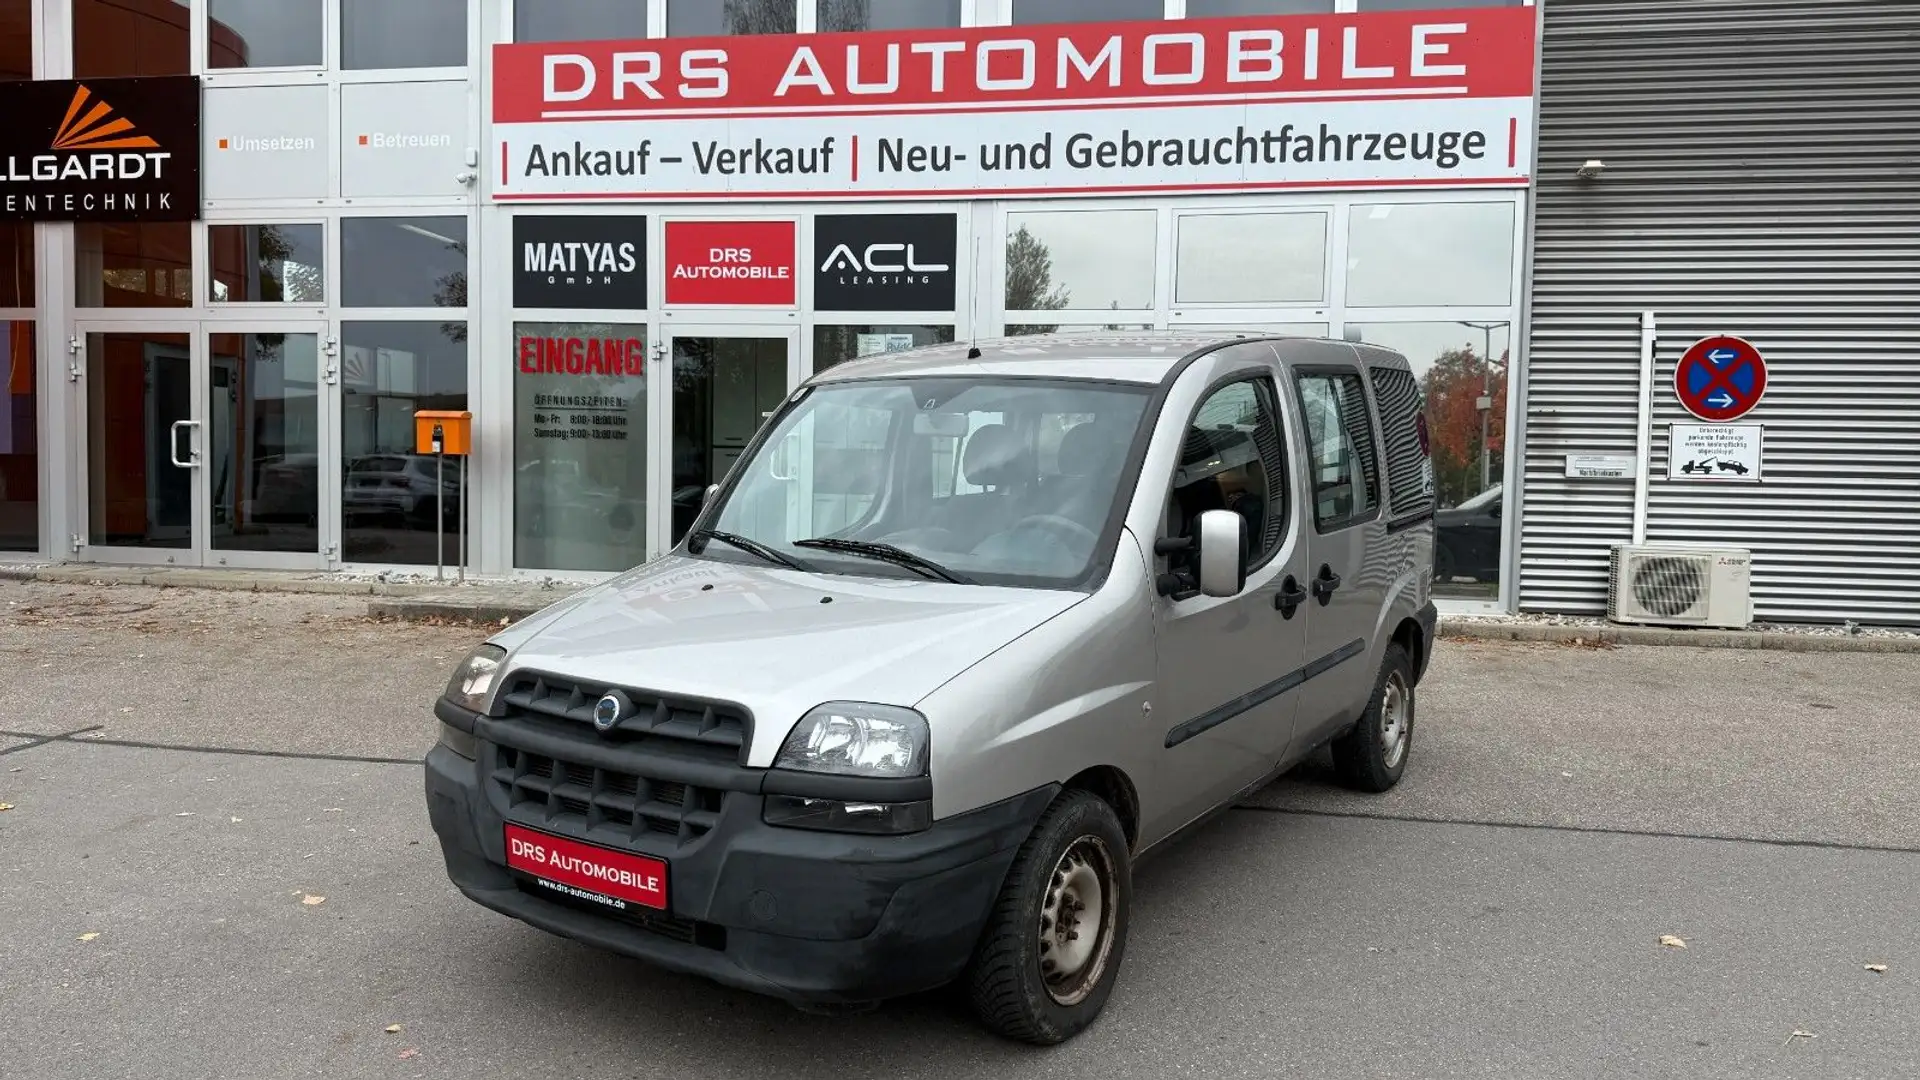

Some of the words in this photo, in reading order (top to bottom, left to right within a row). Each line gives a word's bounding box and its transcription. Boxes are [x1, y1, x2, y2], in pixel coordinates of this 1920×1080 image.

[543, 49, 729, 103] DRS
[773, 22, 1468, 97] AUTOMOBILE
[232, 136, 315, 152] Umsetzen
[373, 132, 451, 148] Betreuen
[524, 139, 651, 177] Ankauf
[692, 136, 834, 175] Verkauf
[878, 137, 967, 172] Neu-
[980, 132, 1052, 170] und
[1065, 124, 1486, 169] Gebrauchtfahrzeuge
[523, 242, 636, 272] MATYAS
[709, 248, 751, 263] DRS
[821, 243, 949, 272] ACL
[673, 263, 789, 279] AUTOMOBILE
[839, 276, 931, 285] LEASING
[519, 336, 643, 376] EINGANG
[511, 838, 546, 863] DRS
[537, 878, 626, 909] www.drs-automobile.de
